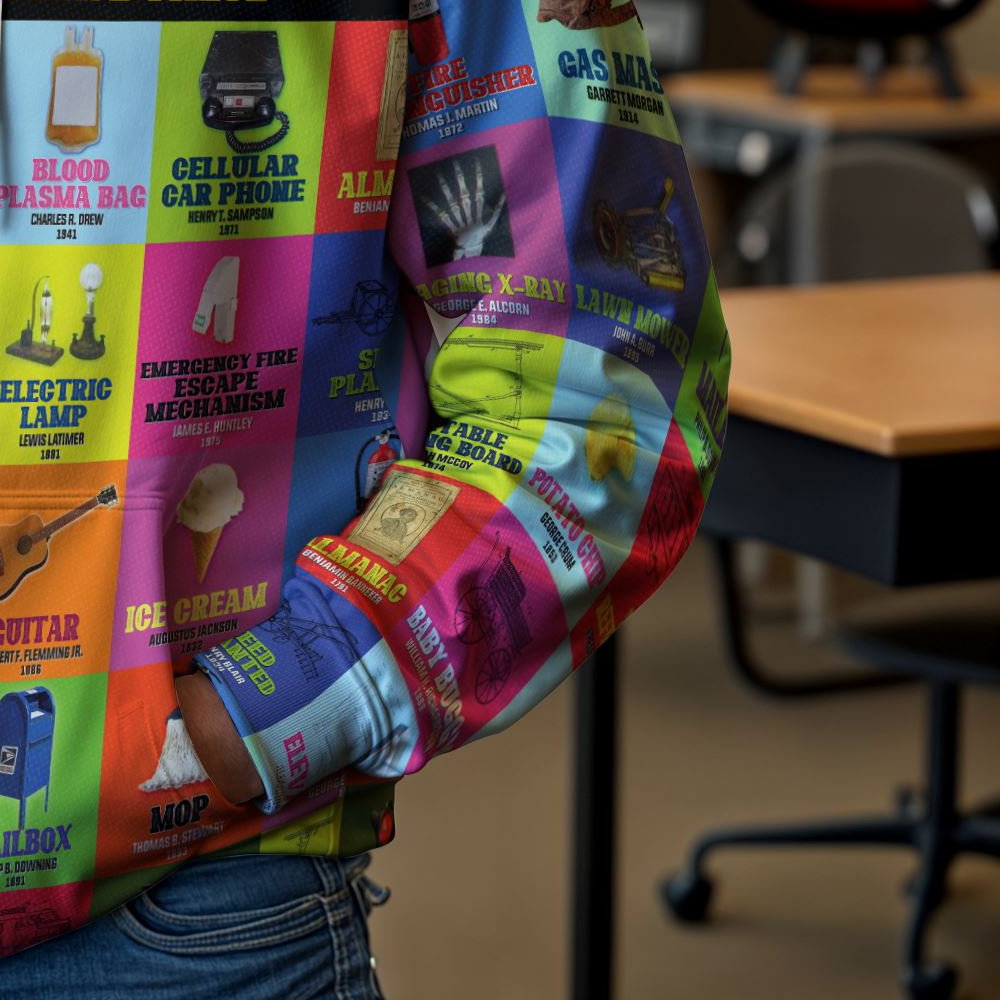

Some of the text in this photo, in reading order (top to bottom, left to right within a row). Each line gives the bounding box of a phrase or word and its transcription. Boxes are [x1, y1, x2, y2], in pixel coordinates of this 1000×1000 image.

[558, 48, 609, 82] GAS
[456, 98, 498, 121] MARTIN
[618, 109, 639, 125] 1914
[438, 123, 464, 138] 1872
[32, 158, 110, 182] BLOOD
[171, 154, 299, 181] CELLULAR
[97, 185, 147, 209] BAG
[161, 179, 306, 207] CAR PHONE
[30, 213, 104, 226] CHARLES R. DREW
[188, 207, 274, 224] HENRY SAMPSON
[56, 229, 77, 240] 1941
[219, 224, 239, 236] 1971
[499, 273, 567, 304] X-RAY
[489, 300, 530, 316] ALCORN
[575, 284, 633, 326] LAWN
[471, 314, 497, 325] 1984
[613, 325, 630, 342] JOHN
[140, 347, 299, 380] EMERGENCY FIRE
[0, 377, 113, 403] ELECTRIC
[174, 371, 259, 398] ESCAPE
[18, 404, 87, 430] LAMP
[144, 388, 287, 424] MECHANISM
[355, 397, 385, 413] HENRY
[172, 417, 254, 437] JAMES HUNTLEY
[18, 432, 85, 447] LEWIS LATIMER
[40, 449, 61, 460] 1881
[437, 454, 474, 471] MCCOY
[455, 439, 523, 477] BOARD
[528, 467, 585, 541] POTATO
[540, 512, 576, 571] GEORGE CRUM
[302, 549, 350, 581] BENJAMIN
[124, 582, 268, 633] ICE CREAM
[149, 619, 238, 647] AUGUSTUS JACKSON
[406, 604, 448, 668] BABY
[24, 646, 69, 662] FLEMMING
[70, 645, 83, 660] JR.
[21, 663, 41, 676] 1886
[224, 660, 245, 685] BLAIR
[149, 794, 210, 834] MOP
[132, 821, 224, 854] THOMAS STEWART
[15, 857, 57, 874] DOWNING
